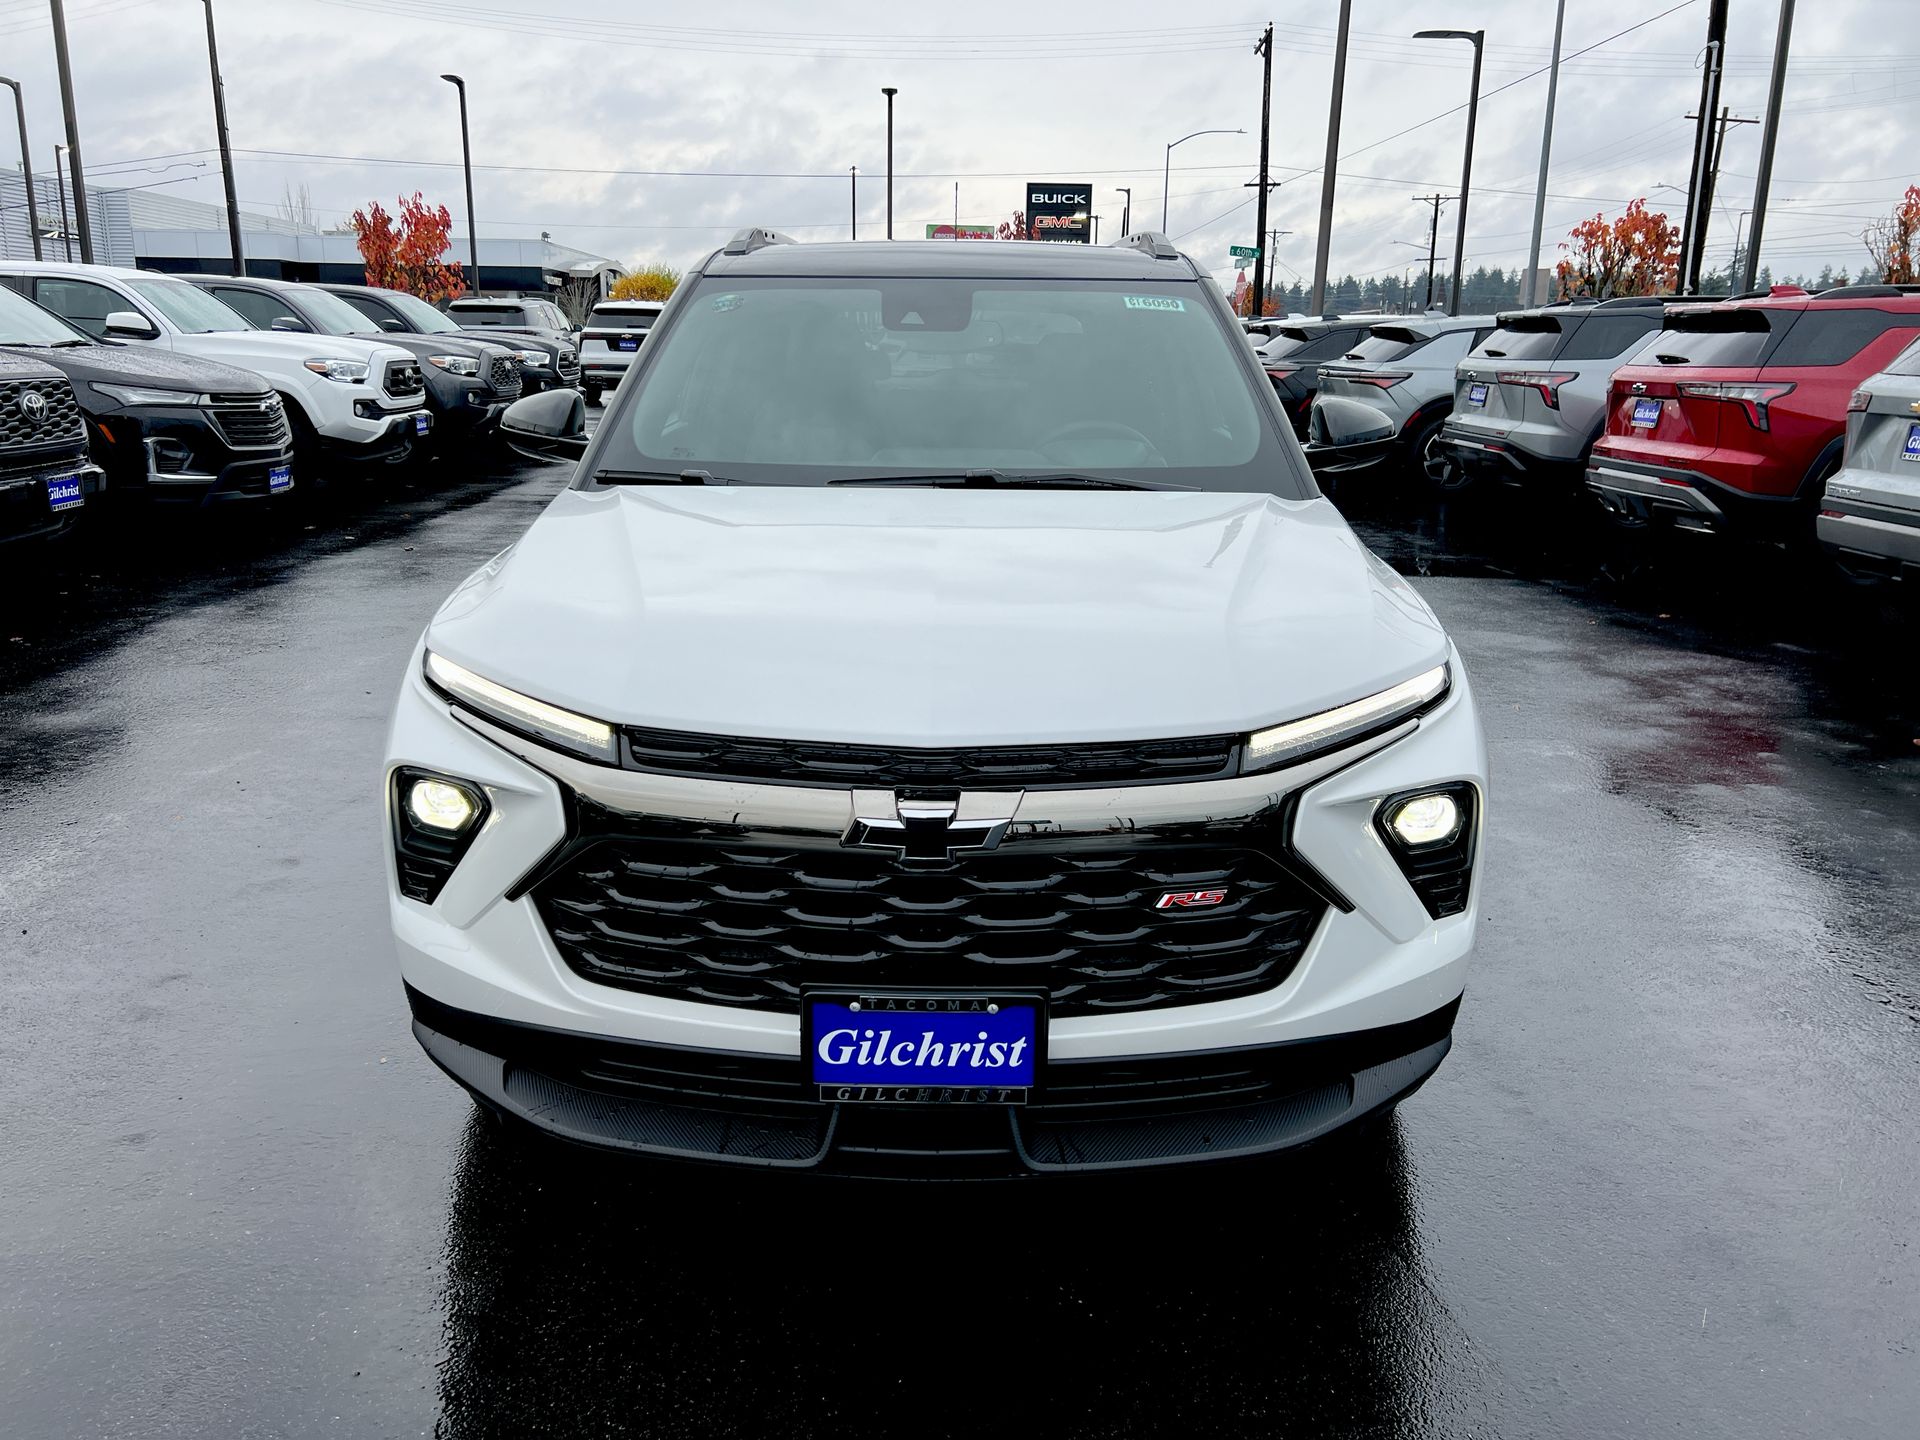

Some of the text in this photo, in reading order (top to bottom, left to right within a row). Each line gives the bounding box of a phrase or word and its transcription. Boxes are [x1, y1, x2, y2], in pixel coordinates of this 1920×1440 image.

[1031, 193, 1087, 204] BUICK
[1035, 216, 1082, 229] GMC
[1236, 248, 1253, 257] 60th
[1634, 407, 1659, 419] Gilchrist
[48, 484, 79, 500] Gilchrist
[1155, 889, 1228, 909] RS
[867, 998, 981, 1012] TACOMA
[817, 1028, 1028, 1068] Gilchrist
[836, 1087, 1011, 1102] GILCHRIST
